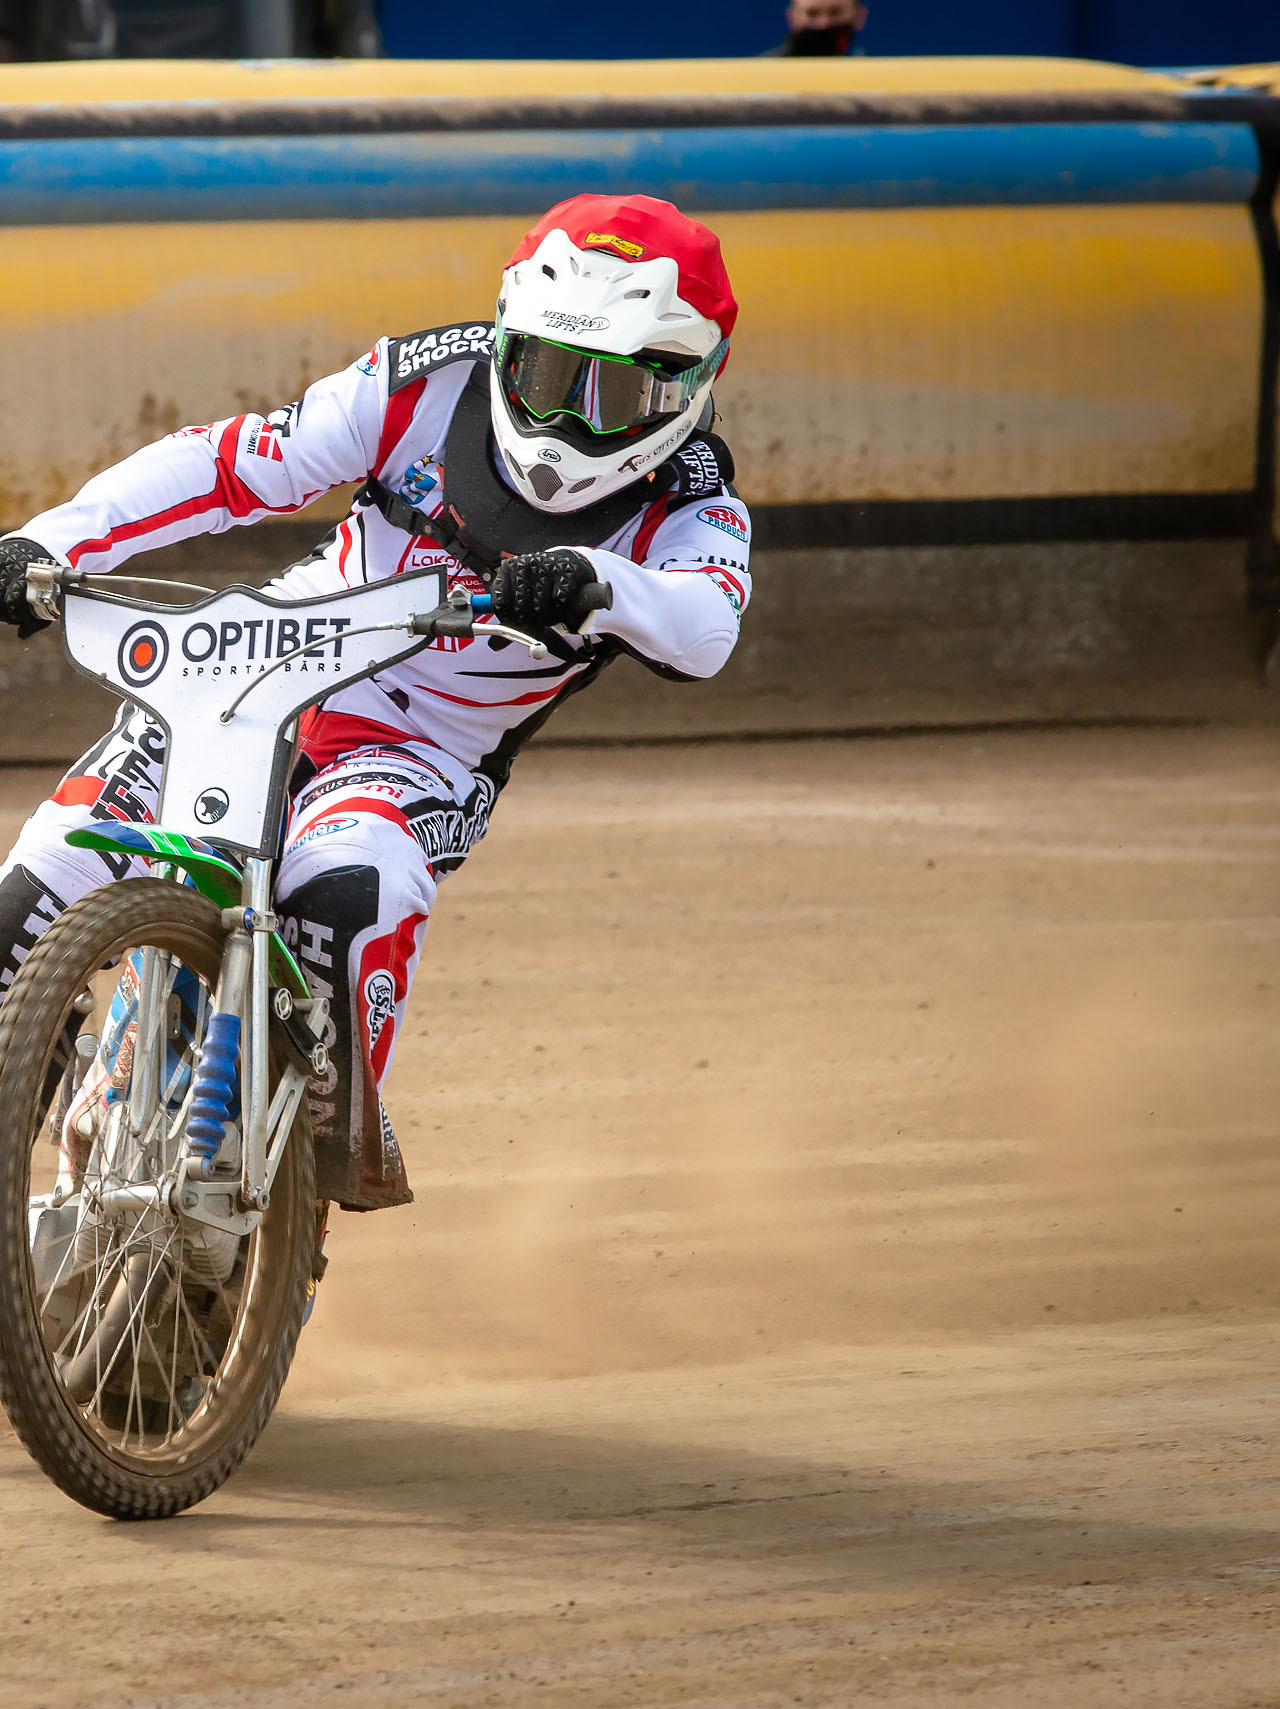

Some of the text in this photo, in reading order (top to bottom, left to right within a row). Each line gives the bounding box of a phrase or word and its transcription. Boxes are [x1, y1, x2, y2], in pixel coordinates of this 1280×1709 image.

[541, 310, 597, 328] MERIDIAN
[546, 319, 579, 332] LIFTS
[397, 339, 494, 378] SHOCK
[688, 440, 721, 492] ERIDIA
[708, 516, 746, 540] PRODUCTS
[182, 618, 351, 662] OPTIBET
[182, 660, 341, 677] SPORTA BĀRS
